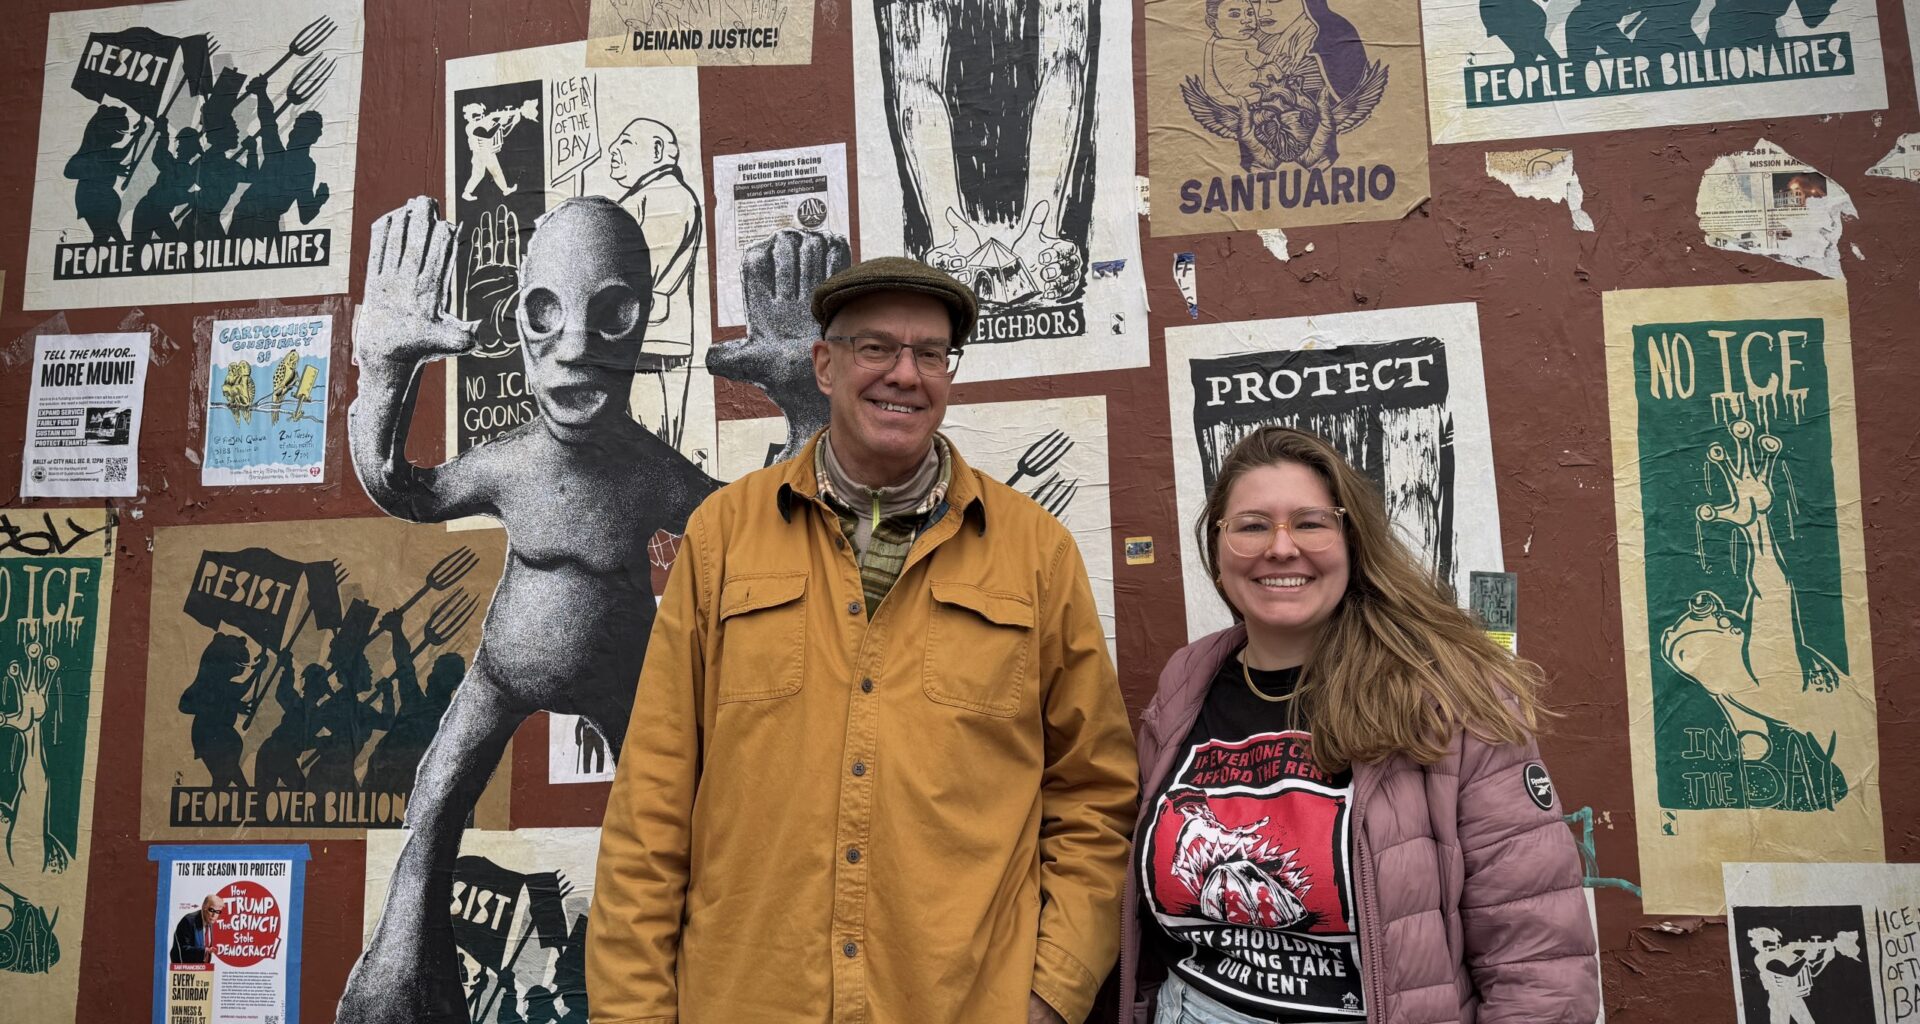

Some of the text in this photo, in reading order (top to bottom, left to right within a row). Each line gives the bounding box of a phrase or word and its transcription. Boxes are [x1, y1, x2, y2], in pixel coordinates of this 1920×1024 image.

[633, 27, 779, 51] DEMAND JUSTICE!
[84, 41, 168, 87] RESIST
[1474, 37, 1847, 103] PEOPLE OVER BILLIONAIRES
[556, 76, 577, 98] ICE
[555, 95, 579, 116] OUT
[554, 112, 590, 134] OF THE
[557, 132, 591, 166] BAY
[737, 157, 822, 172] Elder Neighbors Facing
[742, 167, 818, 181] Eviction Right Now!!!
[1749, 158, 1802, 168] MISSION MAR
[1179, 164, 1396, 214] SANTUARIO
[61, 233, 325, 276] PEOPLE OVER BILLIONAIRES
[219, 321, 324, 344] CARTOONIST
[968, 309, 1080, 342] EIGHBORS
[44, 348, 136, 360] TELL THE MAYOR...
[232, 337, 313, 352] CONSPIRACY
[41, 360, 135, 387] MORE MUNI!
[1205, 354, 1434, 406] PROTECT
[1648, 330, 1809, 412] NO ICE
[466, 375, 486, 403] NO
[38, 408, 84, 417] EXPAND SERVICE
[464, 400, 534, 431] GOONS
[61, 439, 87, 447] TENANTS
[18, 565, 91, 636] ICE
[198, 561, 291, 615] RESIST
[1210, 742, 1285, 768] EVERYONE
[1682, 727, 1732, 761] IN
[1190, 768, 1253, 785] AFFORD
[1257, 760, 1281, 783] THE
[1682, 730, 1837, 811] THE BAY
[177, 791, 406, 823] PEOPLE OVER BILLION
[176, 862, 286, 877] 'TIS THE SEASON TO PROTEST!
[231, 885, 247, 896] How
[223, 897, 274, 915] TRUMP
[450, 881, 512, 931] SIST
[216, 914, 279, 933] The GRINCH
[1883, 906, 1914, 933] ICE
[217, 938, 281, 959] DEMOCRACY!
[234, 932, 254, 944] Stole
[1220, 928, 1342, 960] SHOULDN'T
[1885, 931, 1917, 957] OUT
[1217, 957, 1251, 985] OUR
[1256, 970, 1309, 996] TENT
[1289, 956, 1347, 977] TAKE
[1888, 962, 1904, 980] OF
[173, 973, 195, 987] EVERY
[172, 988, 209, 1001] SATURDAY
[1893, 984, 1920, 1023] BA
[172, 1005, 182, 1016] VAN
[183, 1005, 197, 1016] NESS
